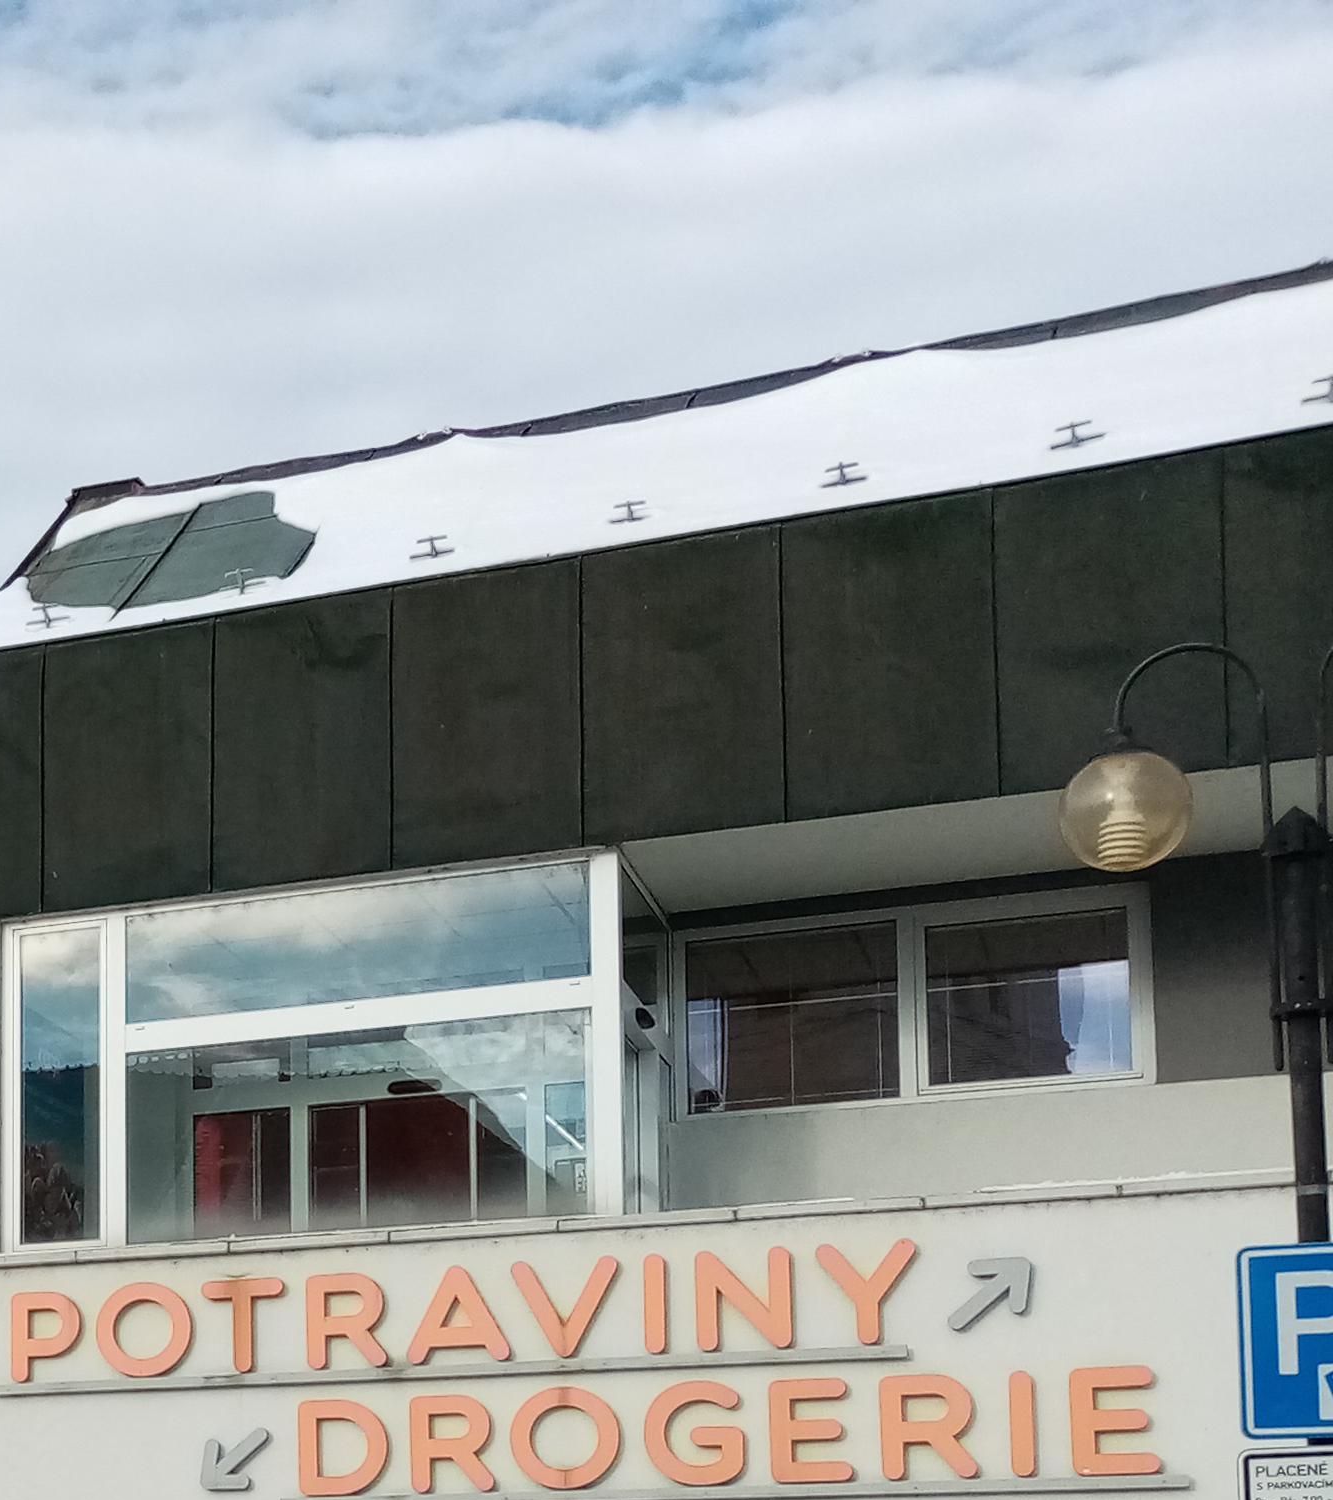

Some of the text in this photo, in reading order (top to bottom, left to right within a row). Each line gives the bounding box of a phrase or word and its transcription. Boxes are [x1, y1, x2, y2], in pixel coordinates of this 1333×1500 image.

[11, 1238, 917, 1384] POTRAVINY
[1275, 1269, 1333, 1376] P
[298, 1365, 1165, 1497] DROGERIE
[1255, 1461, 1329, 1478] PLACENÉ
